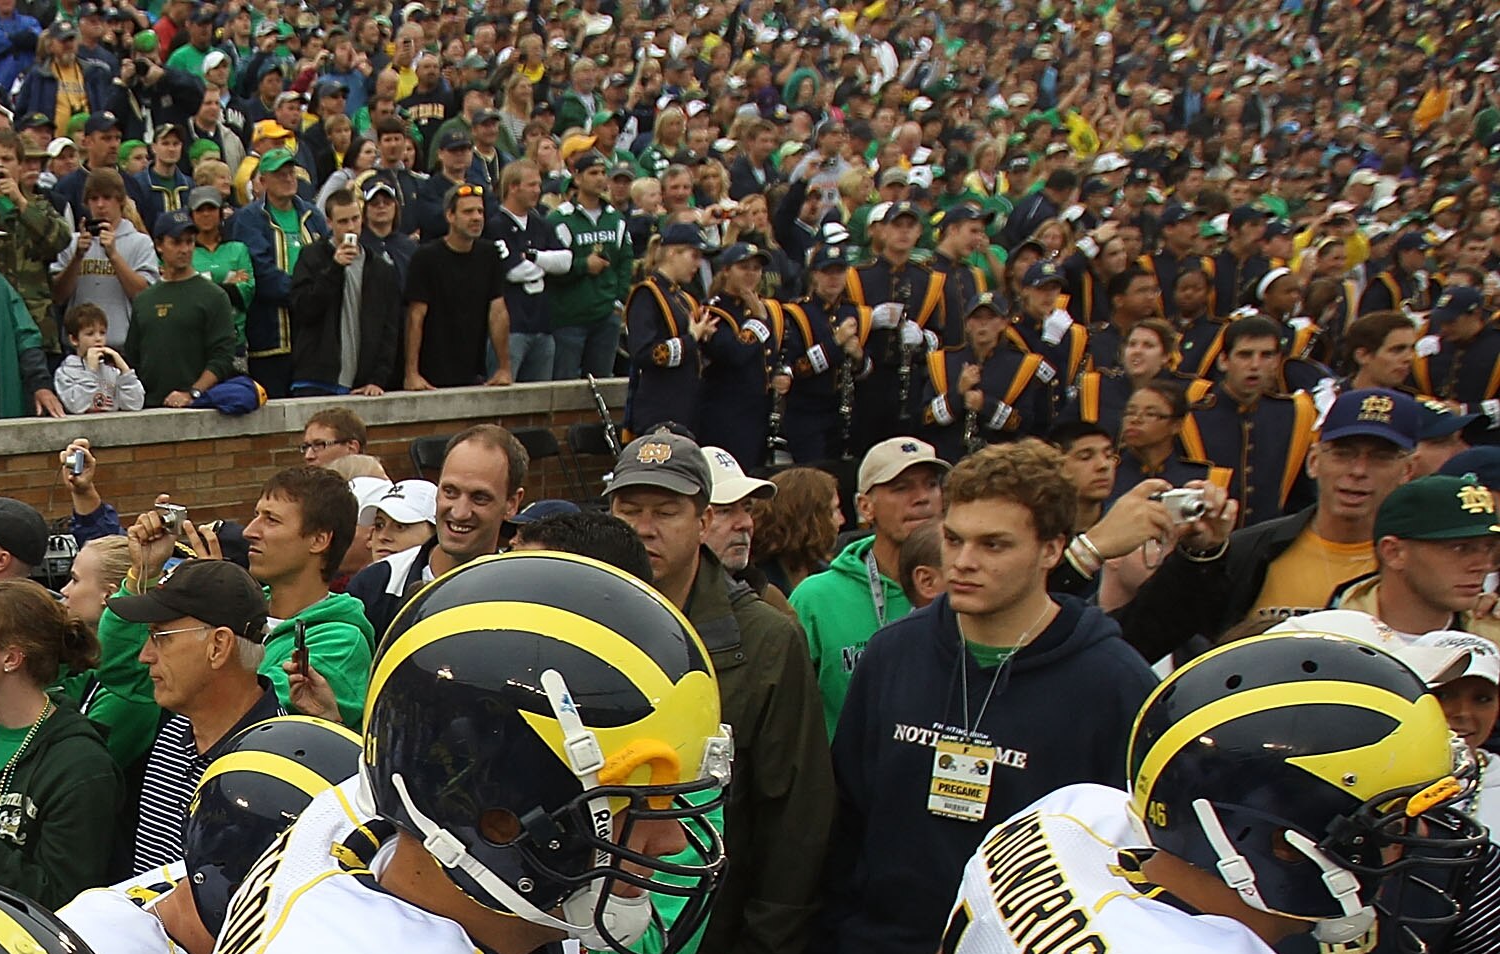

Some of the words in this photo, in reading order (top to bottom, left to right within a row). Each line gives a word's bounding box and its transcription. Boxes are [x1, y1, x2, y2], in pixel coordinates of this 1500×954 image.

[576, 229, 616, 245] IRISH
[938, 783, 982, 798] PREGAME
[1148, 800, 1167, 827] 46
